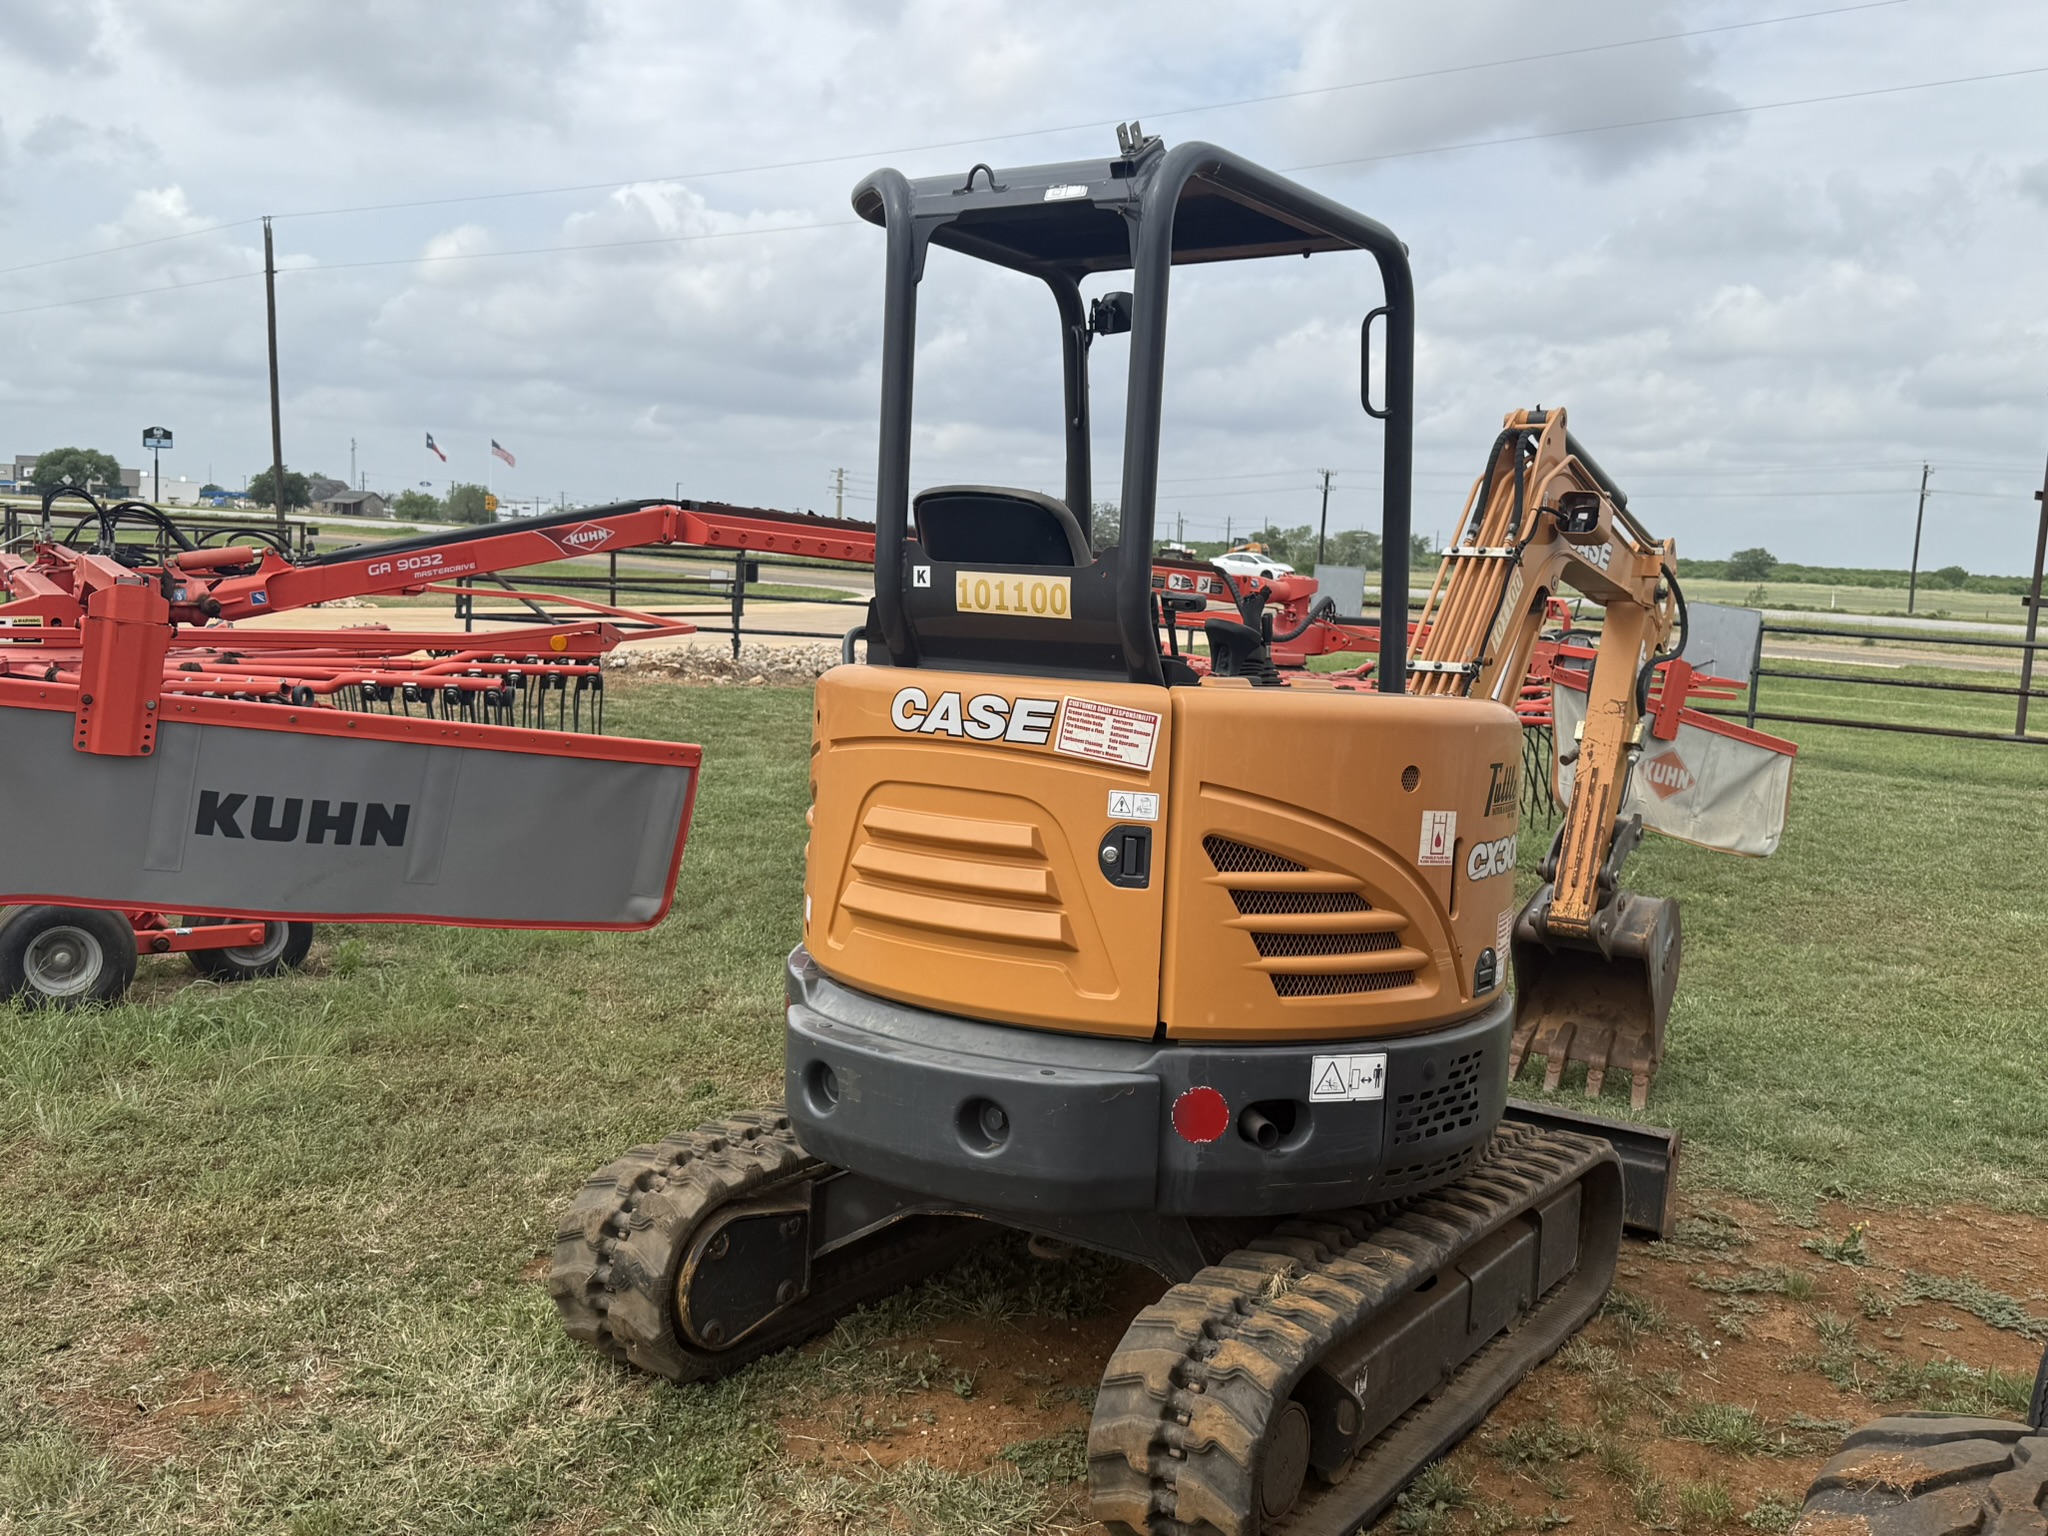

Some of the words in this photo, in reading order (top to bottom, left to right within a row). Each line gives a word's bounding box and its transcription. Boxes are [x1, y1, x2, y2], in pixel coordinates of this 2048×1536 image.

[569, 529, 608, 545] KUHN
[368, 563, 392, 577] GA
[397, 553, 444, 571] 9032
[1569, 542, 1613, 572] ASE
[414, 562, 476, 579] MASTERDRIVE
[916, 569, 927, 584] K
[958, 578, 1067, 615] 101100
[890, 686, 1060, 746] CASE
[1068, 700, 1097, 712] CUSTOMER
[1097, 706, 1112, 714] DAILY
[1112, 709, 1155, 723] RESPONSIBILITY
[1083, 712, 1106, 721] Lubrication
[1644, 760, 1690, 790] KUHN
[195, 790, 411, 847] KUHN
